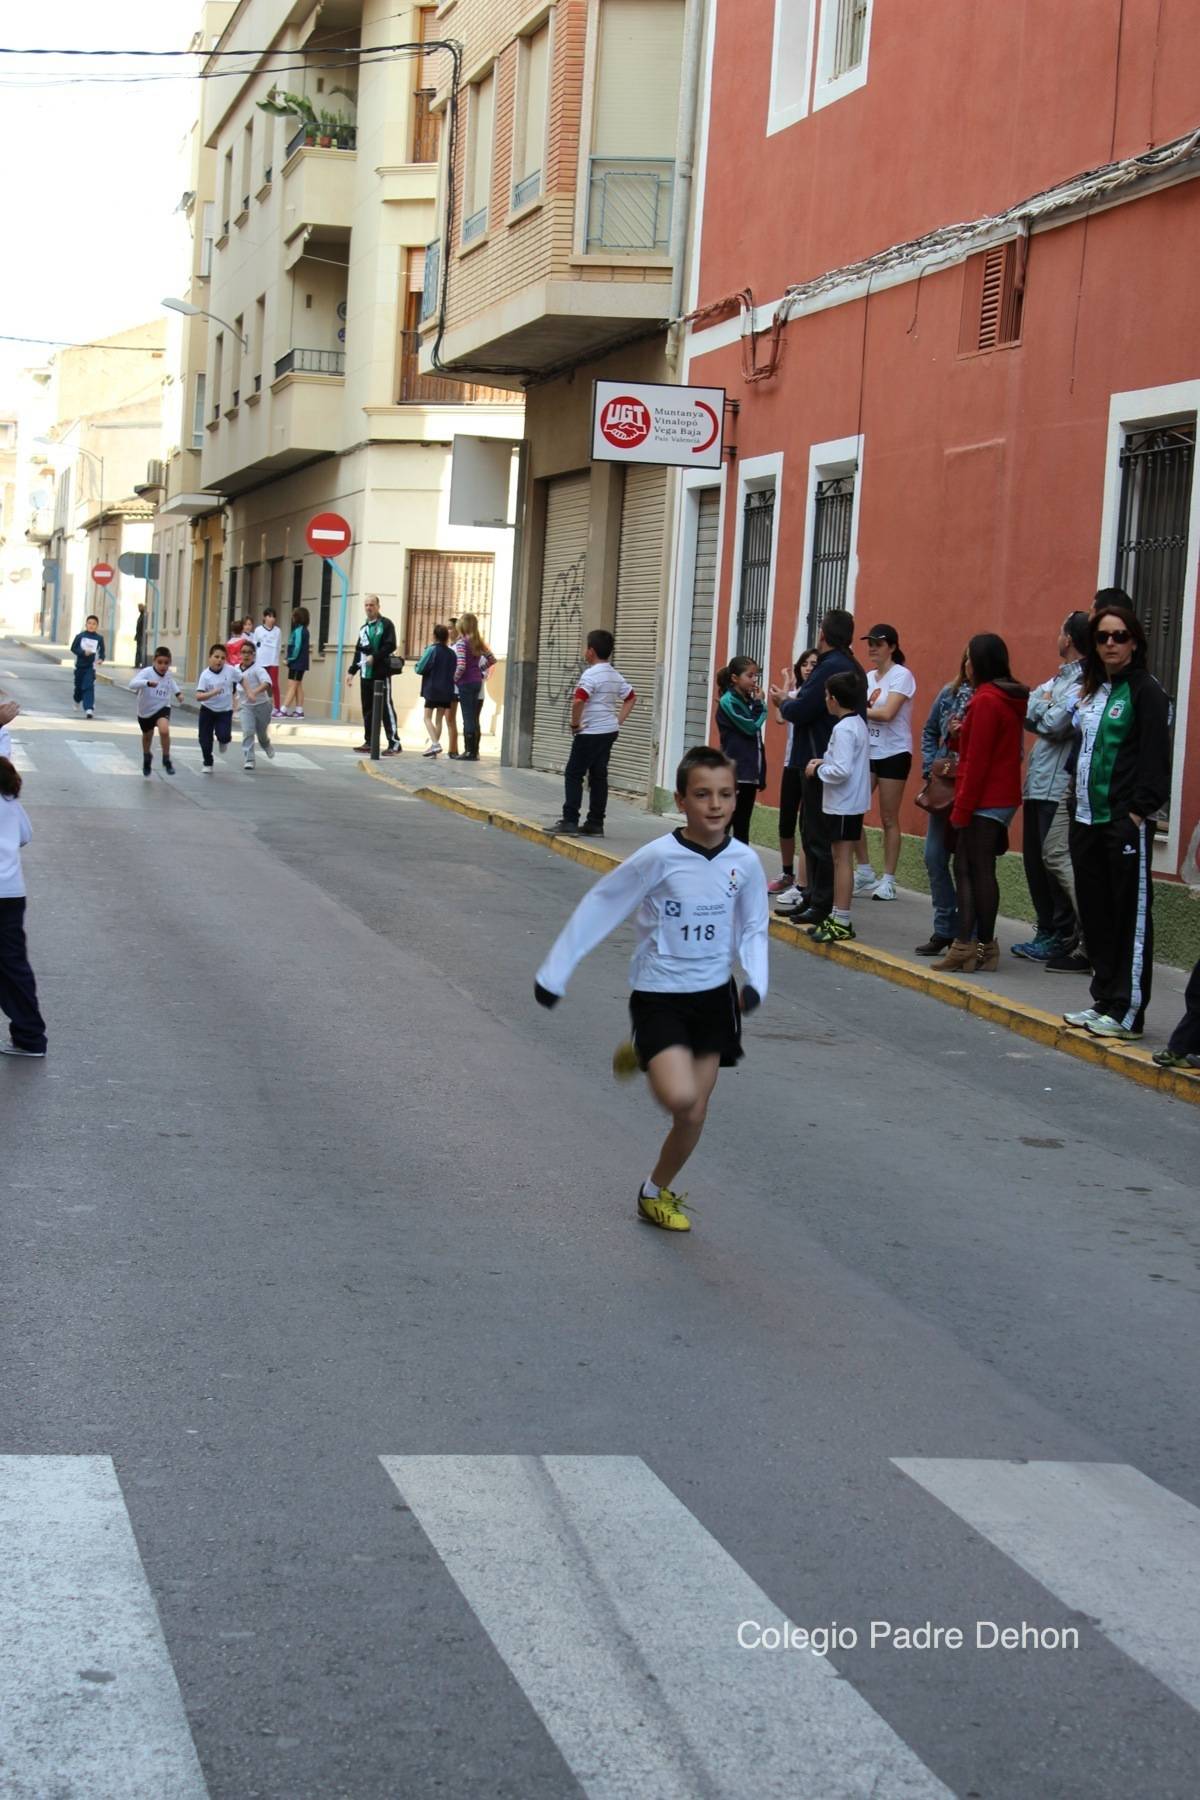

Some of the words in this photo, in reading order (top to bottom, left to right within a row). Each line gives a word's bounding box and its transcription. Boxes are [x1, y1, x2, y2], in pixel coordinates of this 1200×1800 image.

[607, 403, 645, 427] UGT
[655, 408, 704, 418] Muntanya
[654, 425, 677, 435] Vega
[680, 428, 702, 437] Baja
[680, 924, 716, 941] 118
